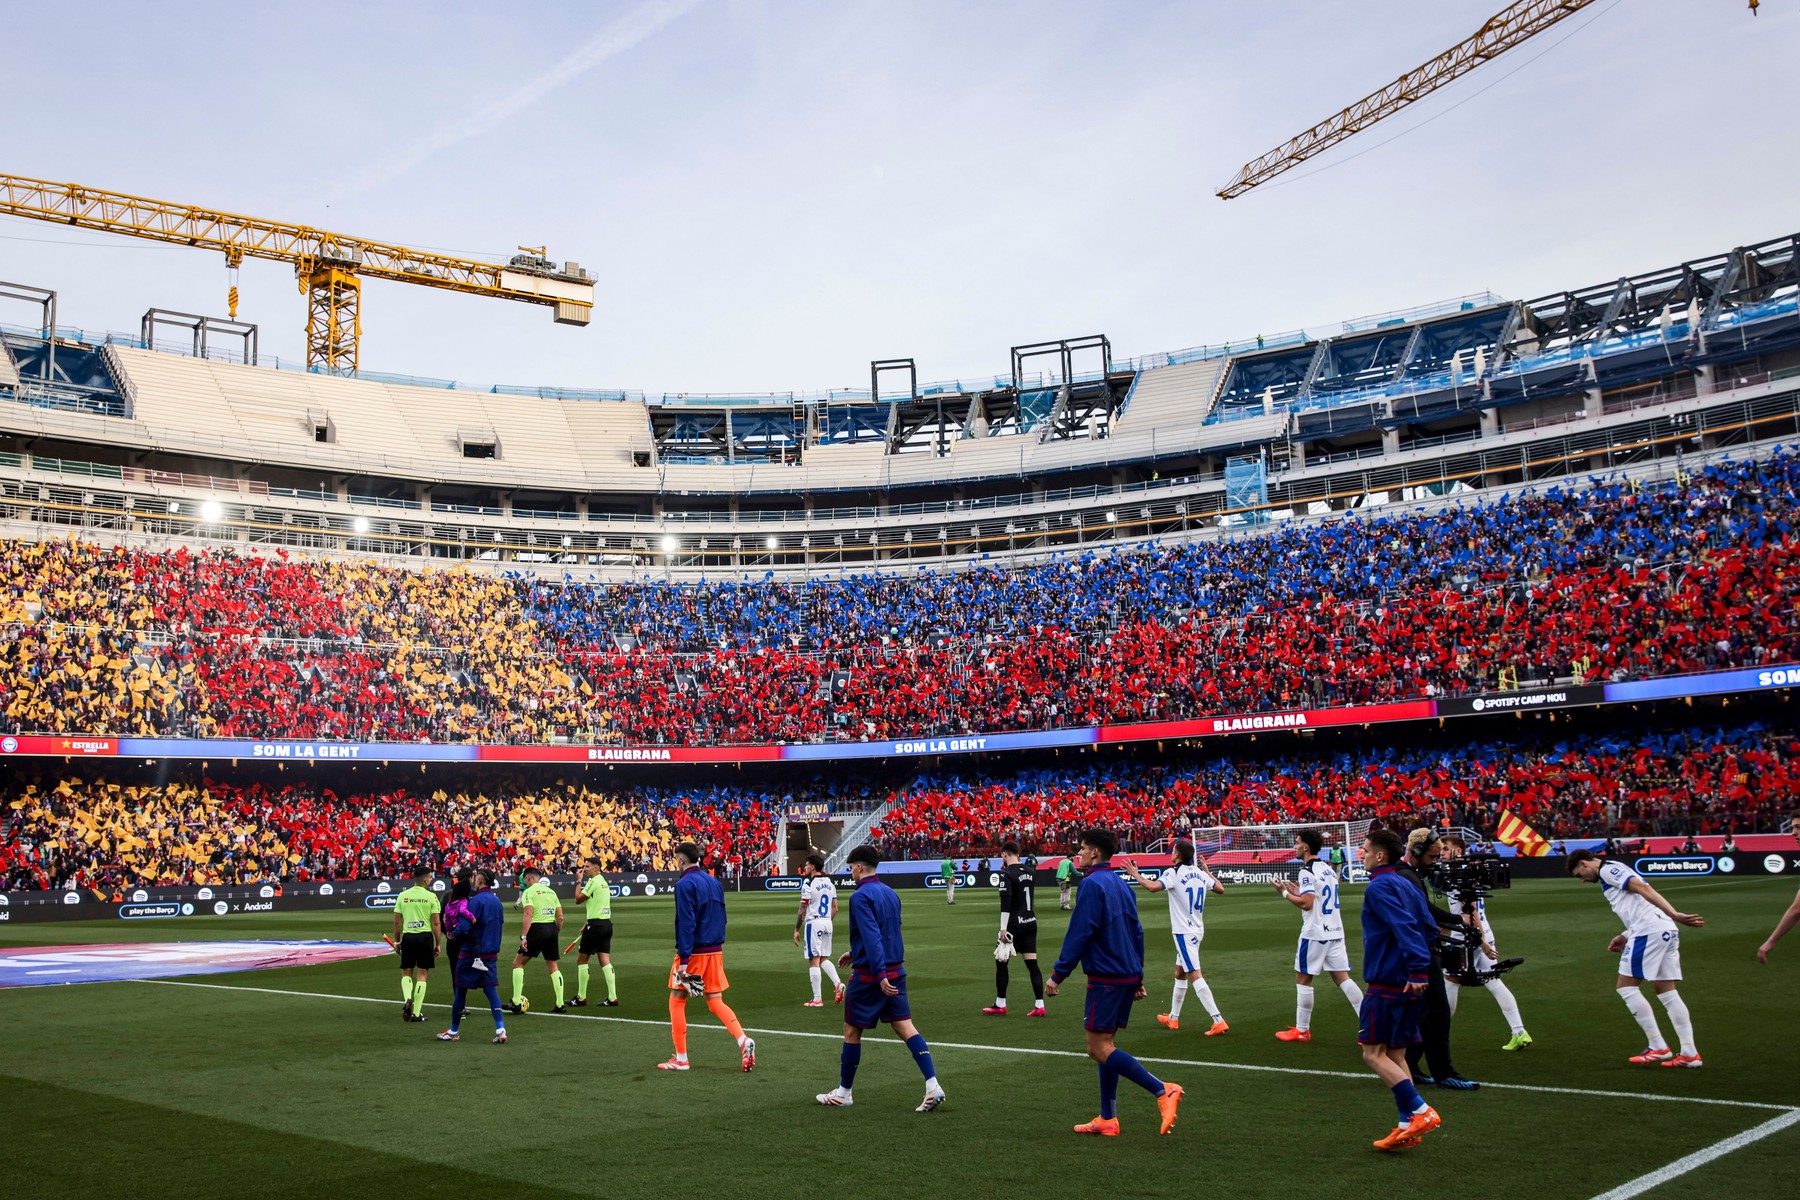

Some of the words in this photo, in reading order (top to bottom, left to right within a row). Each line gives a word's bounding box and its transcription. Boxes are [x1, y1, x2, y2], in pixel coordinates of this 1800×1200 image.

[1485, 697, 1520, 708] SPOTIFY
[1521, 694, 1546, 705] CAMP
[1547, 692, 1567, 702] NOU
[1213, 714, 1307, 731] BLAUGRANA
[72, 741, 109, 750] ESTRELLA
[895, 742, 926, 753] SOM
[930, 741, 947, 752] LA
[950, 739, 987, 750] GENT
[253, 745, 290, 757] SOM
[295, 745, 315, 757] LA
[318, 746, 360, 758] GENT
[588, 749, 671, 760] BLAUGRANA
[789, 805, 800, 815] LA
[805, 804, 829, 815] CAVA
[1647, 862, 1667, 871] play
[1667, 861, 1682, 869] the
[1683, 861, 1708, 871] Barça
[1217, 869, 1244, 878] Android
[931, 877, 941, 885] play
[1023, 887, 1031, 911] 1
[1185, 887, 1205, 914] 14
[129, 907, 144, 916] play
[156, 906, 175, 915] Barça
[244, 901, 273, 911] Android
[817, 894, 829, 917] 8
